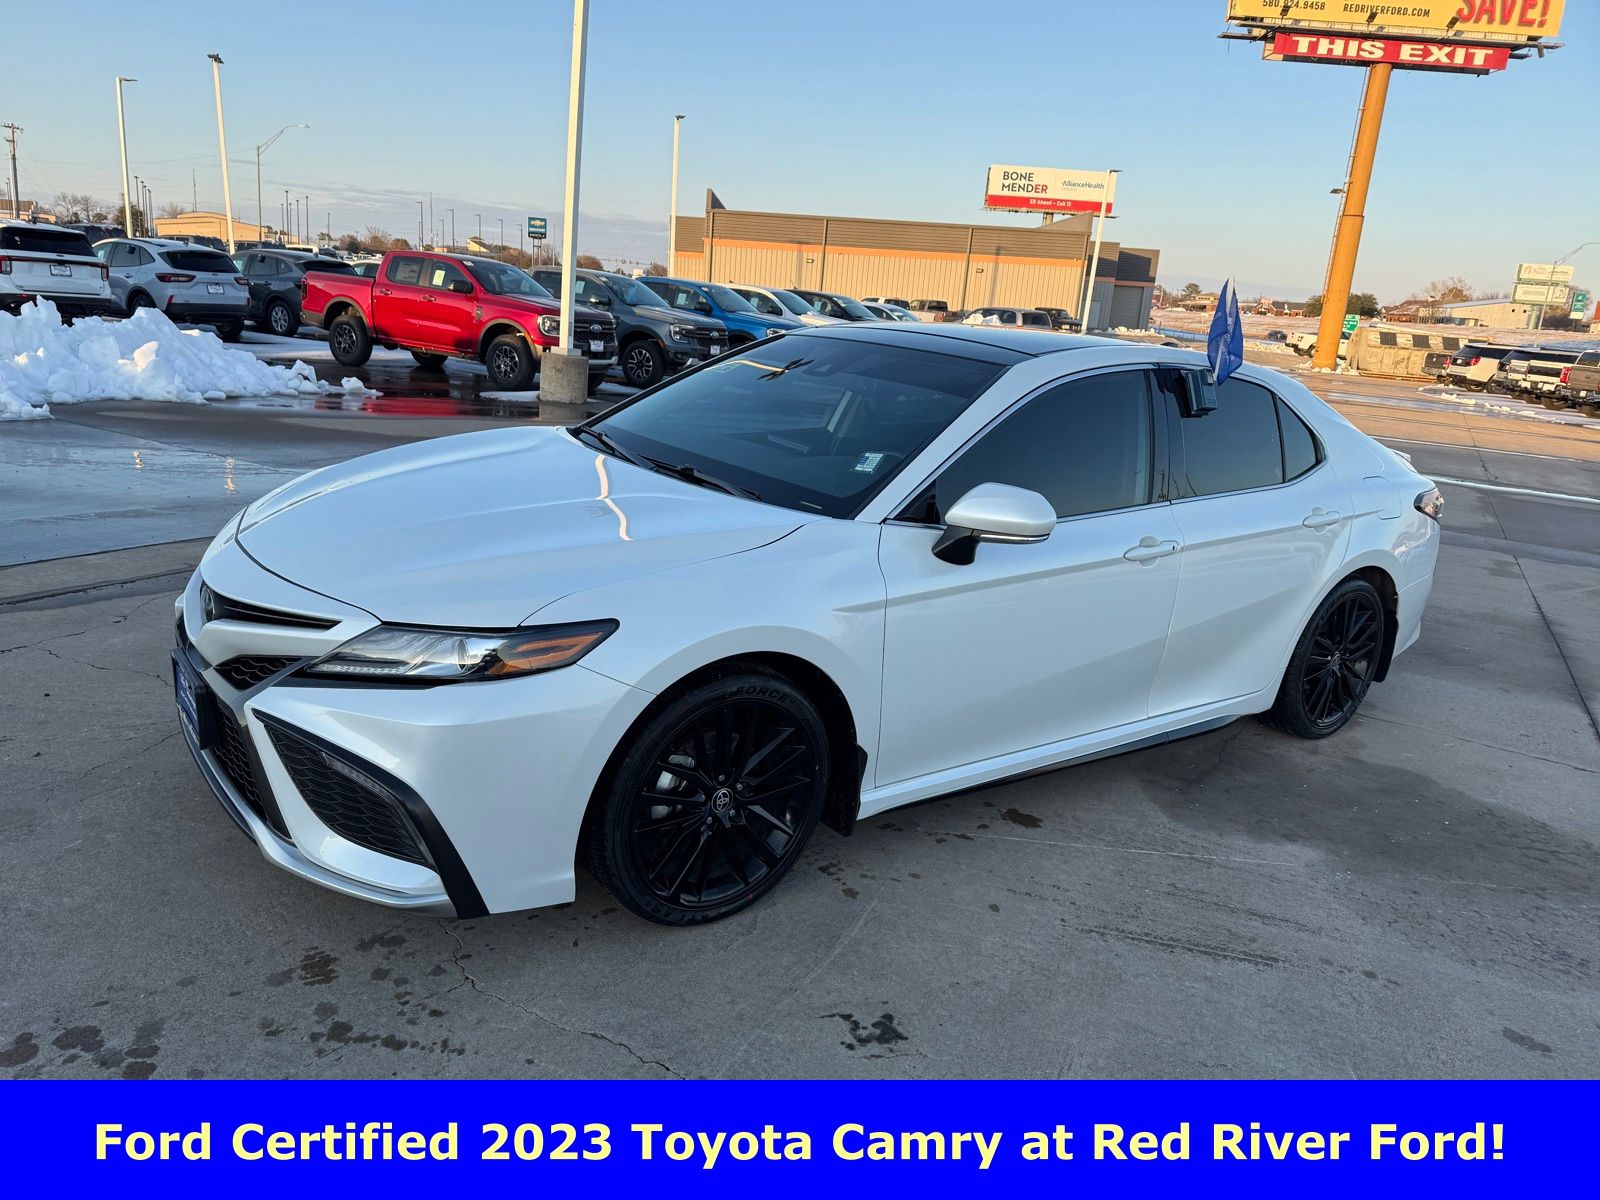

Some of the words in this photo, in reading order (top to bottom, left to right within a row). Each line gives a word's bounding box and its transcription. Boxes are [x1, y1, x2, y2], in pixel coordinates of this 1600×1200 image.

[1343, 3, 1431, 17] REDRIVERFORD.COM
[1455, 0, 1551, 28] SAVE!
[1292, 36, 1386, 59] THIS
[1399, 43, 1494, 66] EXIT
[1002, 170, 1035, 182] BONE
[1001, 182, 1048, 194] MENDER
